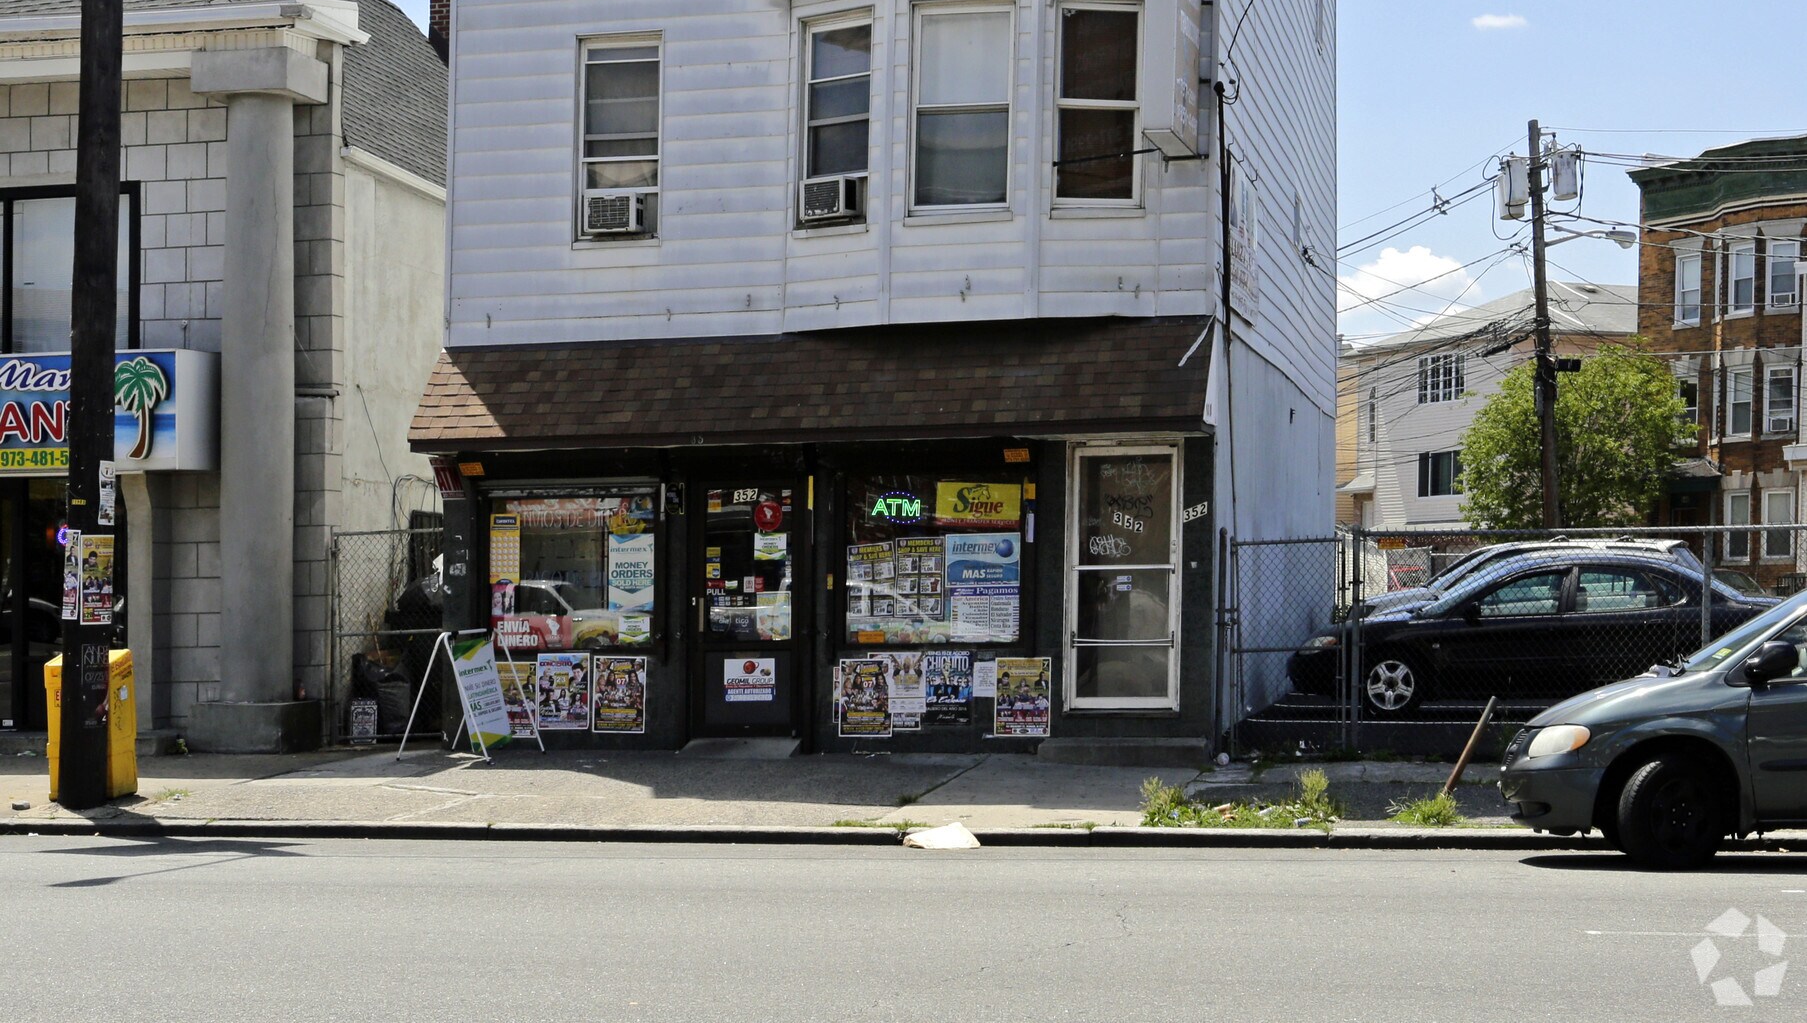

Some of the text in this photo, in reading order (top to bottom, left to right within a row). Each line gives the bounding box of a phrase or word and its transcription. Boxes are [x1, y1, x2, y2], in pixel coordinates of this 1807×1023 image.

[0, 401, 71, 443] AN
[735, 489, 757, 502] 352
[953, 486, 1004, 517] Sigue
[872, 498, 921, 517] ATM
[1185, 503, 1207, 521] 352
[1114, 513, 1143, 532] 352
[615, 561, 648, 569] MONEY
[611, 569, 653, 579] ORDERS
[962, 569, 986, 579] MAS
[612, 579, 631, 587] SOLD
[976, 587, 1018, 595] Pagamos
[497, 618, 530, 633] ENVÍA
[735, 617, 749, 626] tigo
[497, 634, 538, 647] DINERO
